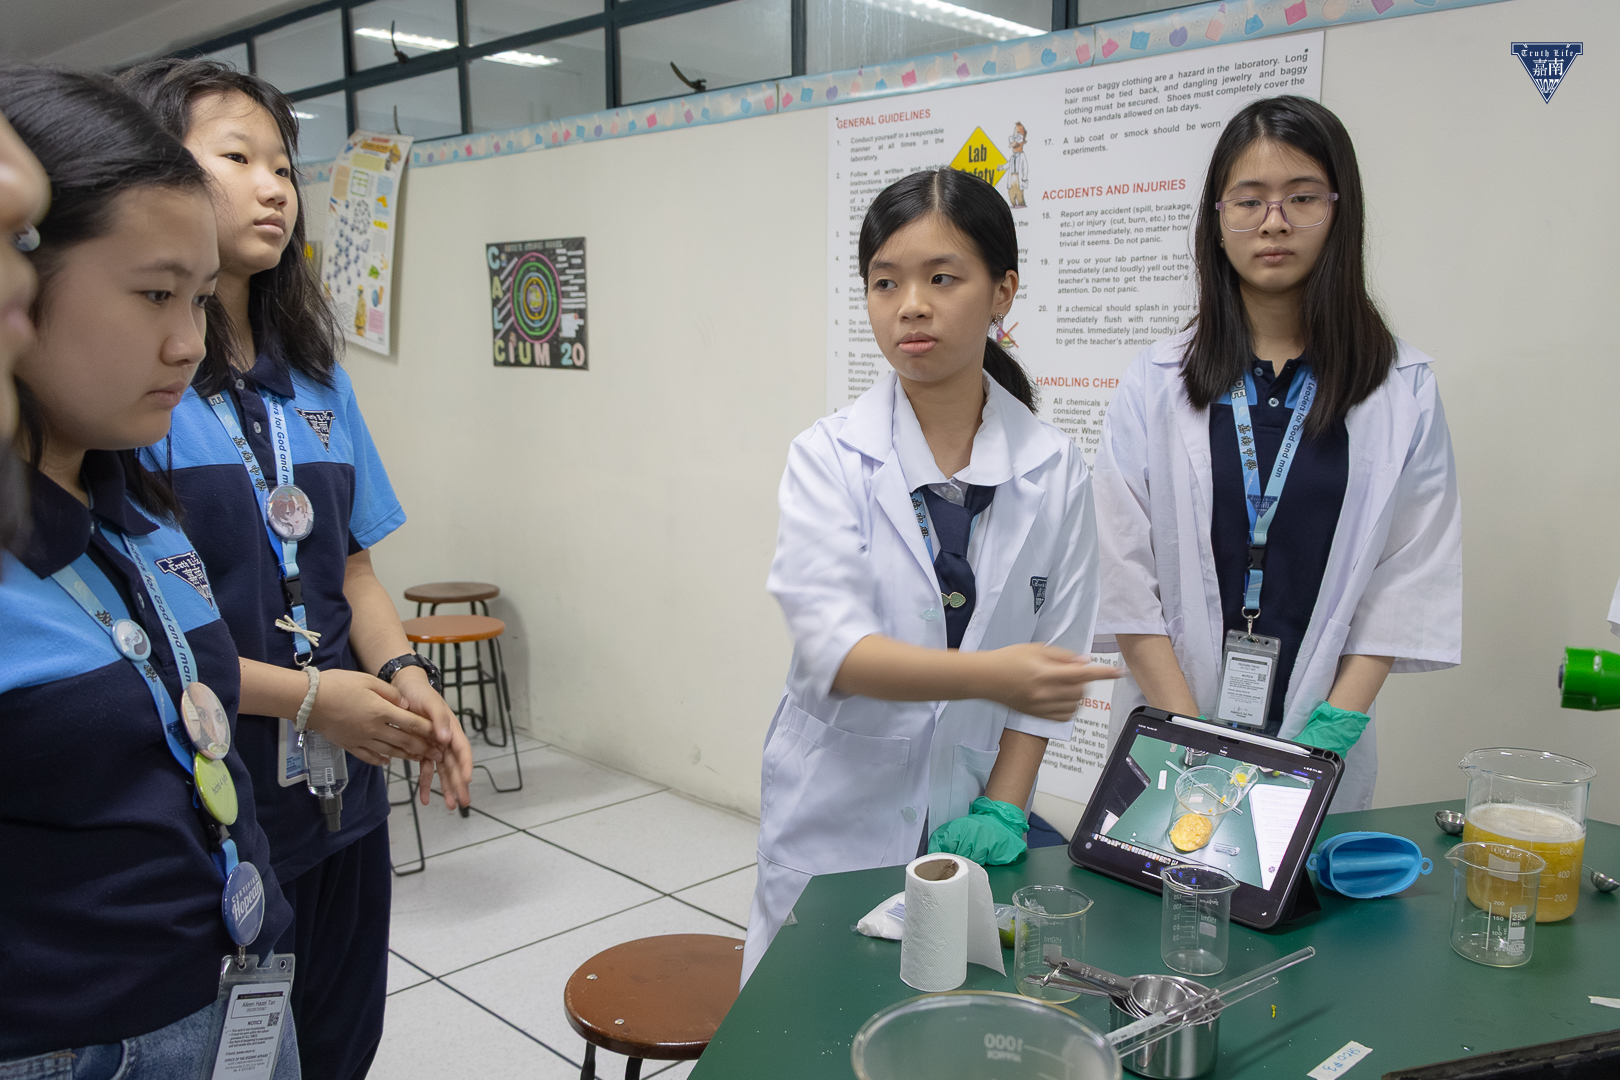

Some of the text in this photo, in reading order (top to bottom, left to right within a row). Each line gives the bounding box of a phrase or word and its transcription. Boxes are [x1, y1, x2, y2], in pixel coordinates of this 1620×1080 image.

[1065, 86, 1085, 94] loose
[1097, 81, 1121, 91] baggy
[1121, 76, 1153, 87] clothing
[1154, 74, 1168, 82] are
[1177, 67, 1205, 78] hazard
[1206, 66, 1215, 74] in
[1216, 64, 1230, 73] the
[1234, 58, 1280, 70] laboratory.
[1285, 53, 1308, 63] Long
[1064, 97, 1078, 105] hair
[1081, 94, 1100, 102] must
[1118, 89, 1133, 98] tied
[1139, 85, 1160, 95] back,
[1163, 82, 1179, 92] and
[1182, 78, 1218, 89] dangling
[1221, 72, 1252, 86] jewelry
[1258, 68, 1276, 79] and
[1280, 65, 1308, 76] baggy
[1064, 76, 1305, 115] clothing must be secured. Shoes must completely cover the
[836, 108, 931, 129] GENERAL GUIDELINES
[1081, 116, 1092, 124] No
[1093, 112, 1122, 122] sandals
[1123, 107, 1153, 119] allowed
[1154, 107, 1165, 115] on
[1166, 104, 1179, 113] lab
[1179, 103, 1202, 112] days.
[1062, 137, 1069, 145] A
[1073, 135, 1085, 143] lab
[1088, 133, 1105, 142] coat
[1109, 132, 1119, 140] or
[1124, 127, 1149, 138] smock
[1153, 123, 1180, 135] should
[1186, 122, 1197, 131] be
[1200, 120, 1221, 129] worn
[968, 144, 987, 163] Lab
[1062, 144, 1108, 156] experiments.
[1042, 178, 1186, 200] ACCIDENTS AND INJURIES
[1060, 210, 1084, 219] Report
[1100, 206, 1132, 215] accident
[1132, 204, 1154, 214] (spill,
[1059, 220, 1076, 228] etc.)
[1085, 218, 1107, 228] injury
[1110, 217, 1127, 226] (cut,
[1128, 216, 1148, 224] burn,
[1149, 214, 1167, 223] etc.)
[1059, 230, 1086, 238] teacher
[1087, 226, 1132, 236] immediately,
[1145, 225, 1171, 233] matter
[1059, 239, 1079, 248] trivial
[1114, 237, 1125, 245] Do
[1140, 235, 1163, 245] panic.
[1058, 257, 1064, 265] If
[1066, 258, 1081, 266] you
[1094, 257, 1112, 265] your
[1115, 255, 1127, 263] lab
[1130, 255, 1158, 264] partner
[1161, 253, 1169, 261] is
[1058, 266, 1101, 275] immediately
[1101, 265, 1119, 274] (and
[1119, 264, 1146, 274] loudly)
[1146, 264, 1161, 273] yell
[1176, 263, 1189, 271] the
[561, 342, 585, 366] 20
[1036, 376, 1090, 388] HANDLING
[1053, 408, 1091, 416] considered
[1296, 412, 1304, 423] for
[1052, 416, 1086, 424] chemicals
[1082, 427, 1101, 435] When
[1289, 425, 1300, 442] God
[276, 432, 287, 451] God
[1282, 443, 1292, 459] and
[279, 453, 289, 473] and
[1275, 460, 1285, 478] man
[154, 594, 172, 622] God
[168, 623, 184, 649] and
[180, 653, 192, 682] man
[1100, 657, 1111, 665] hot
[1079, 737, 1096, 747] place
[1070, 744, 1104, 759] Use tongs
[1060, 762, 1083, 774] heated.
[1076, 755, 1096, 767] Never
[1557, 871, 1570, 879] 400
[231, 874, 258, 903] CERTIFIED
[1554, 894, 1568, 902] 200
